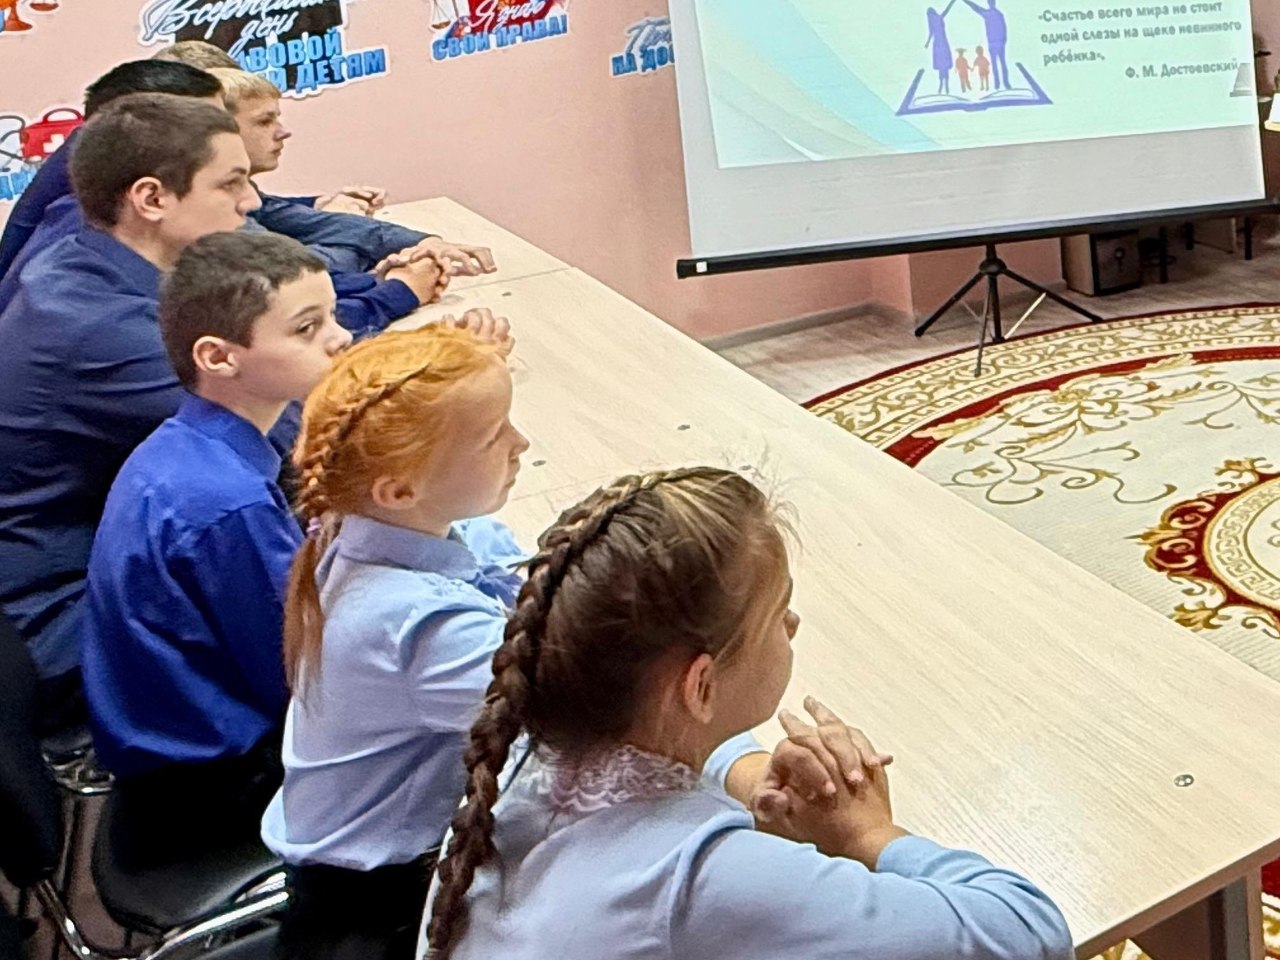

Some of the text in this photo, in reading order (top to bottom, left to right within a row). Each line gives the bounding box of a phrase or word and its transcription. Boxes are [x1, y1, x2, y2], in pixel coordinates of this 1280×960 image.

[1098, 8, 1133, 19] всего
[1136, 5, 1169, 19] мира
[1190, 0, 1223, 13] стоит
[228, 11, 300, 58] день
[432, 14, 568, 61] СВОИ ПРАВА!
[1041, 28, 1079, 44] одной
[1082, 28, 1120, 41] слезы
[1124, 28, 1139, 38] на
[295, 48, 387, 94] ДЕТЯМ
[611, 51, 638, 76] НА
[1161, 58, 1238, 78] Достоевский
